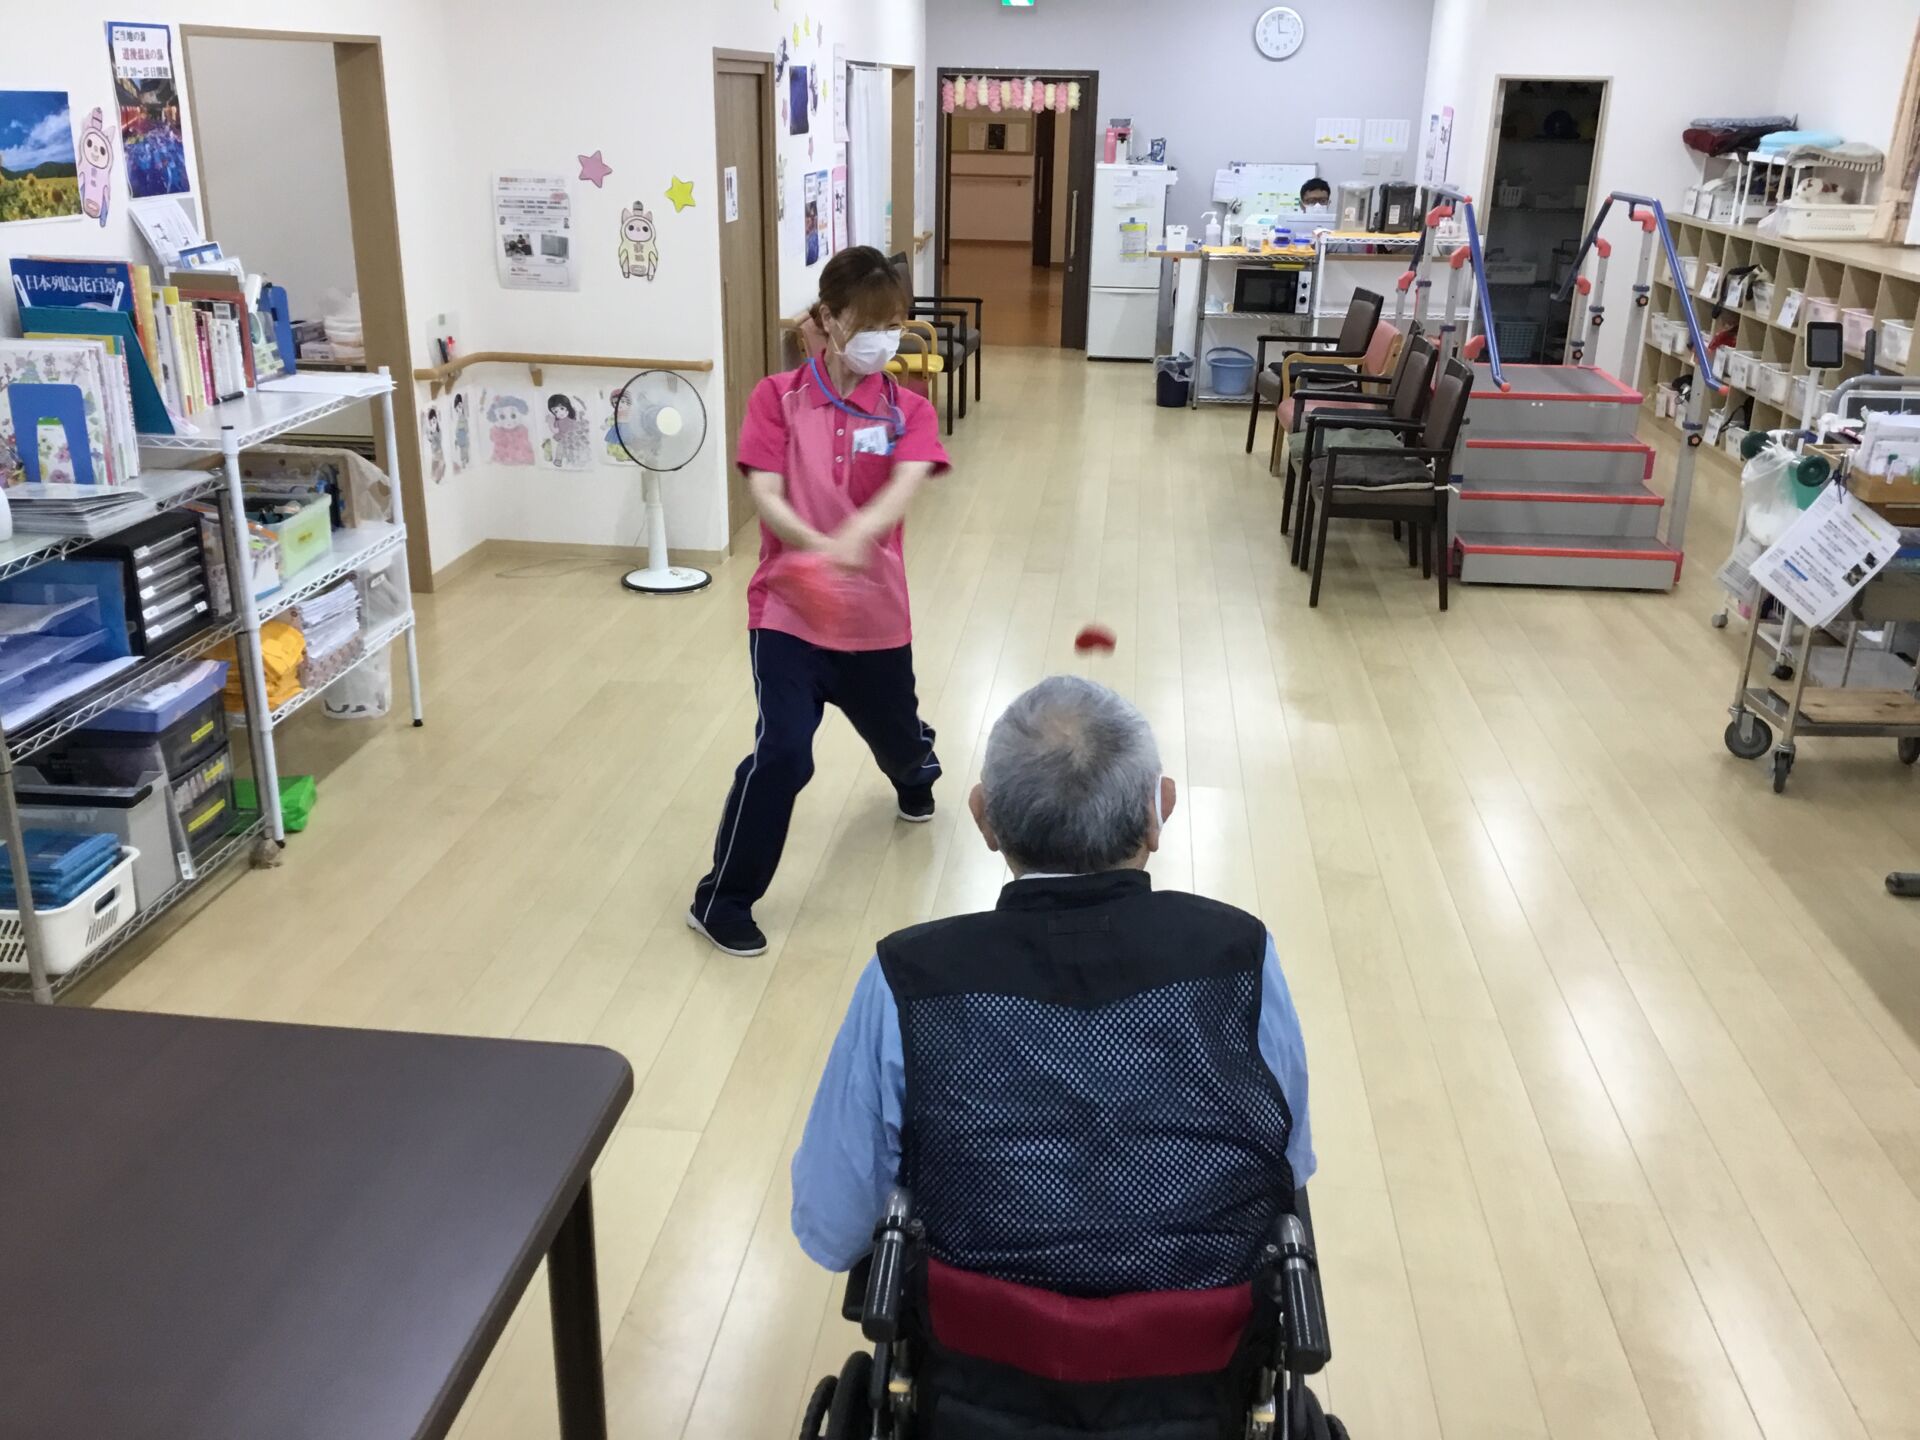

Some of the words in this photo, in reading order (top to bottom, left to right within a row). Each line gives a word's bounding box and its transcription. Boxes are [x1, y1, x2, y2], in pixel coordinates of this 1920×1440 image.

[25, 274, 117, 293] 日本列島花百景
